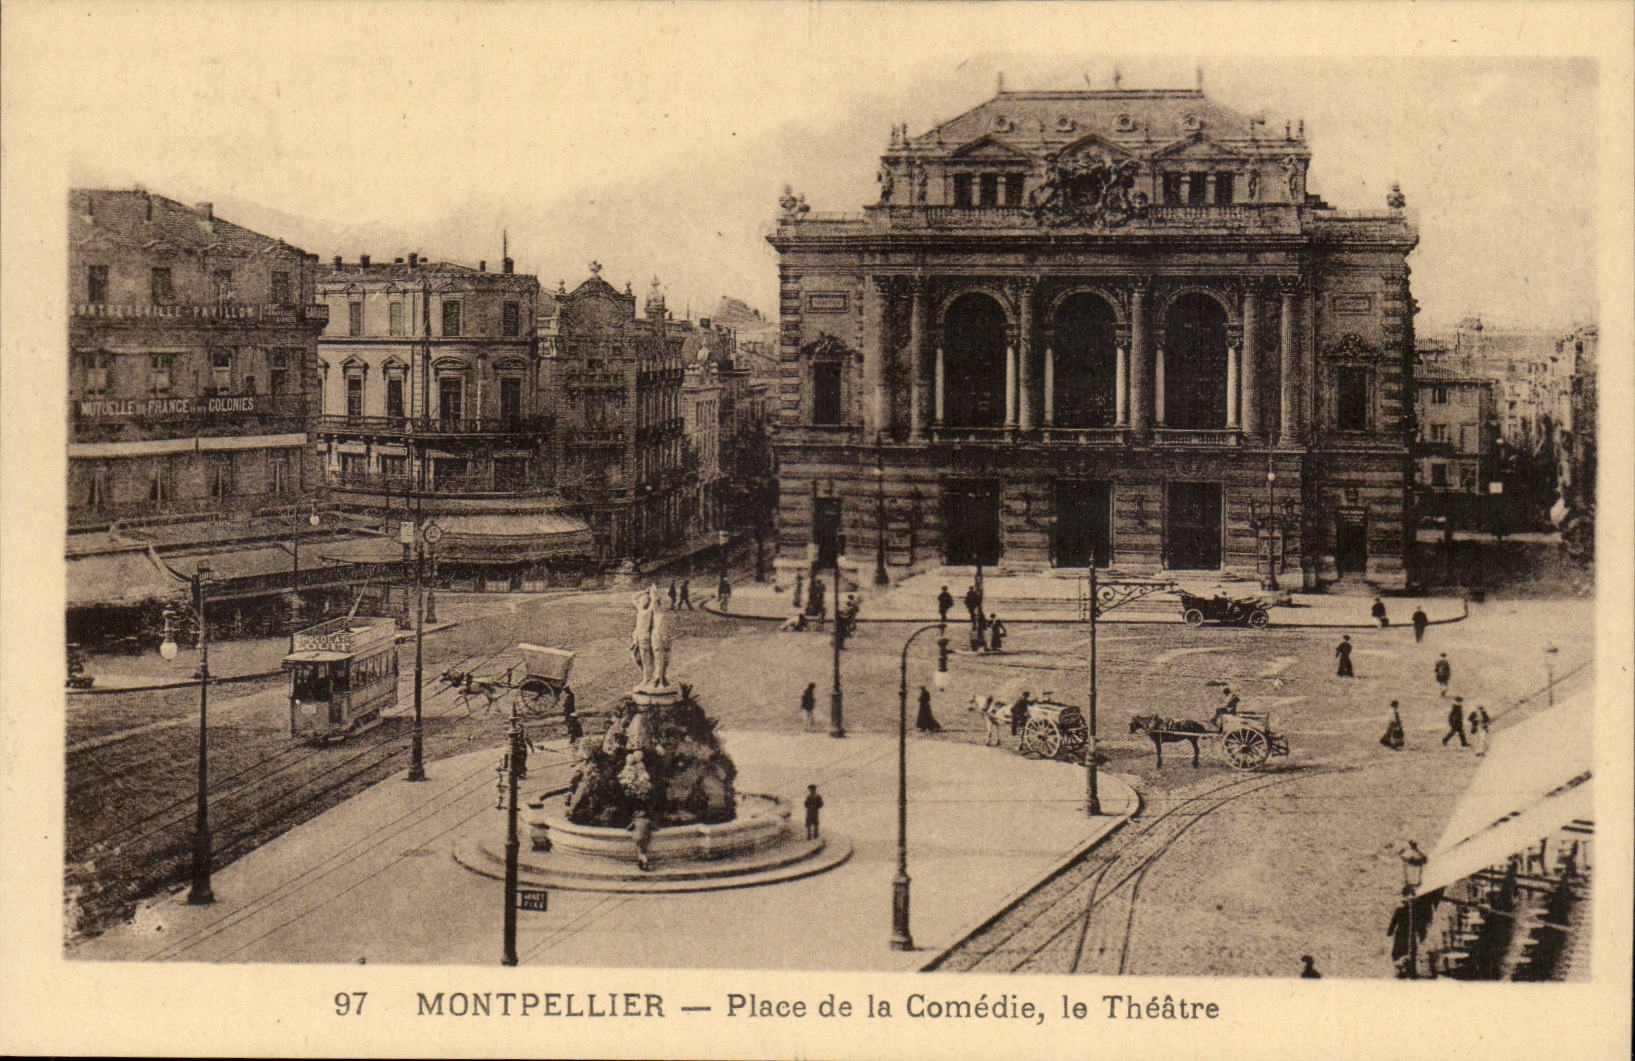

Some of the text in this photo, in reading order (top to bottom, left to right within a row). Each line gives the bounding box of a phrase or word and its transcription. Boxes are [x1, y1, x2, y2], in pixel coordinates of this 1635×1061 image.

[81, 400, 134, 416] MUTUELLE
[148, 399, 189, 414] FRANCE
[208, 397, 254, 412] COLONIES
[296, 634, 347, 644] CHOCOLAT
[296, 643, 352, 652] LOUIT
